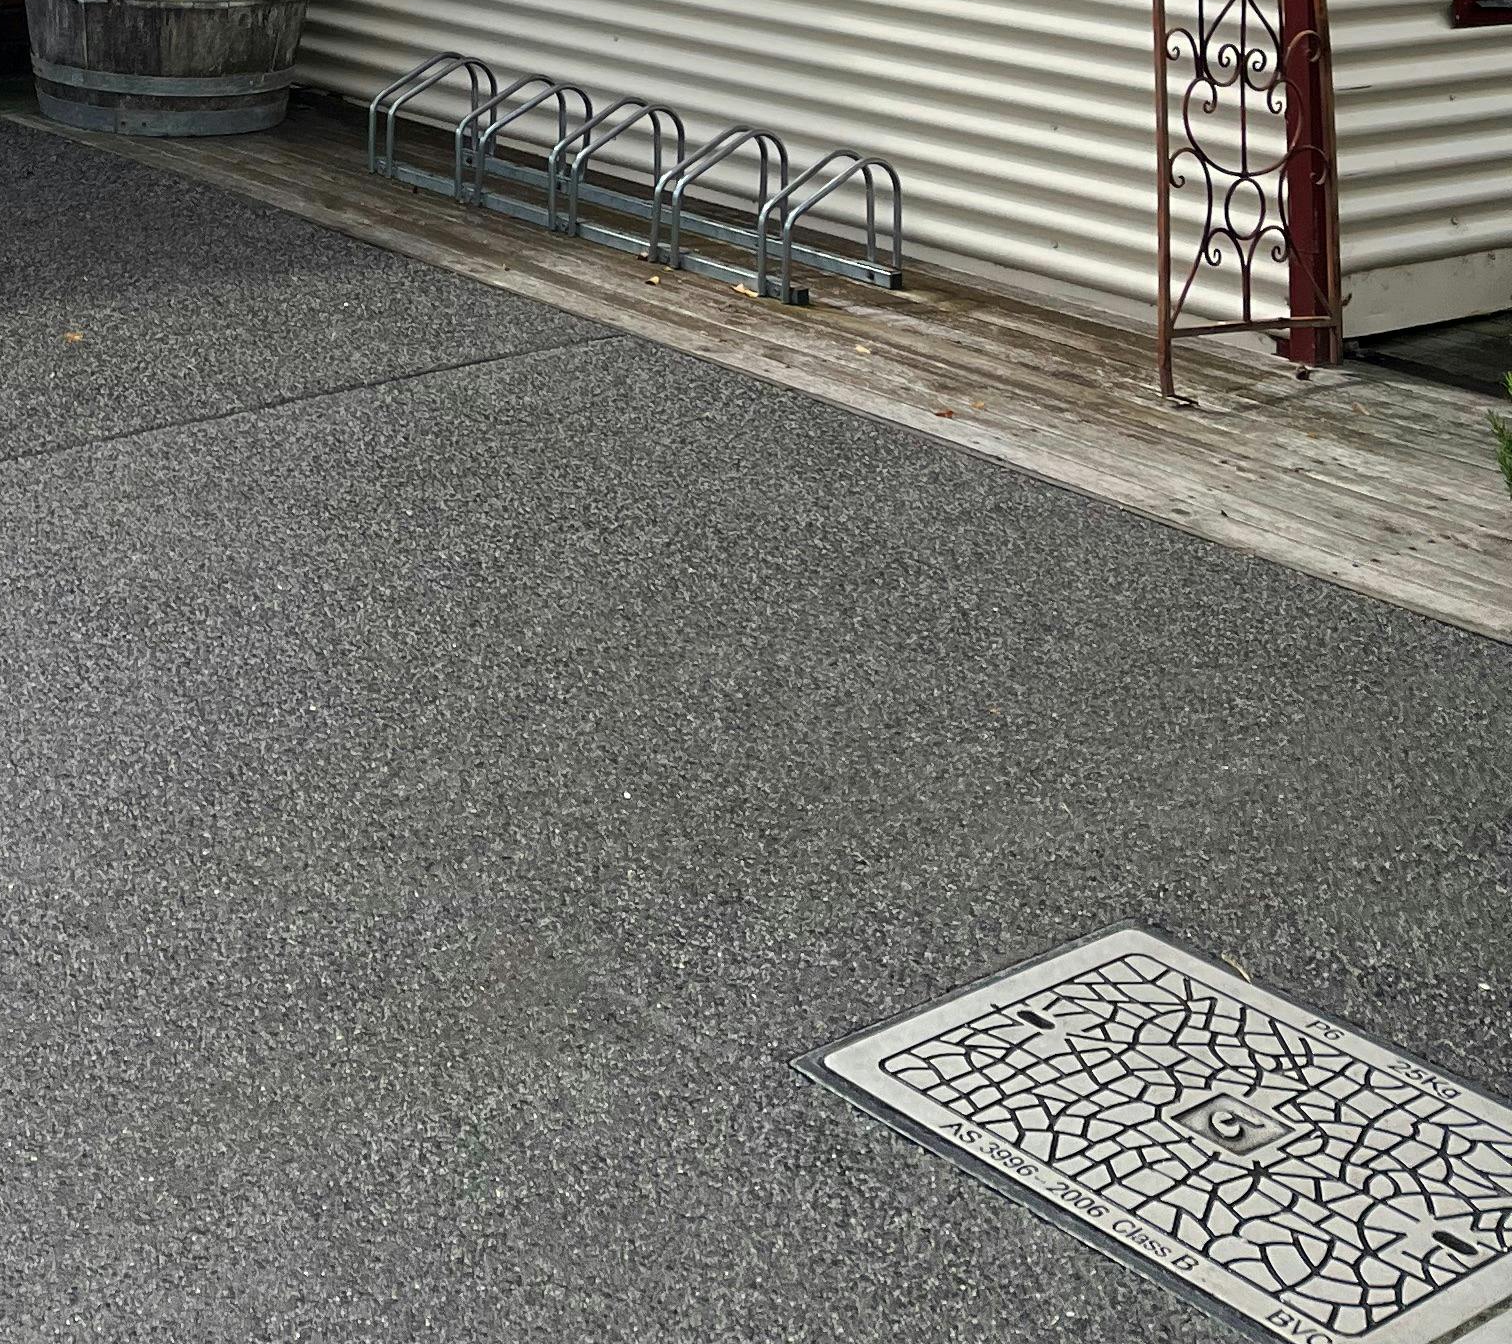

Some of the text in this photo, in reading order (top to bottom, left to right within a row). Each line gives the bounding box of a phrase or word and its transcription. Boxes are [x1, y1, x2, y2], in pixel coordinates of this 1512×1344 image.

[1306, 1019, 1462, 1100] P6 25Kg
[939, 1121, 983, 1144] AS
[1112, 1218, 1173, 1258] Class
[1170, 1254, 1200, 1272] B
